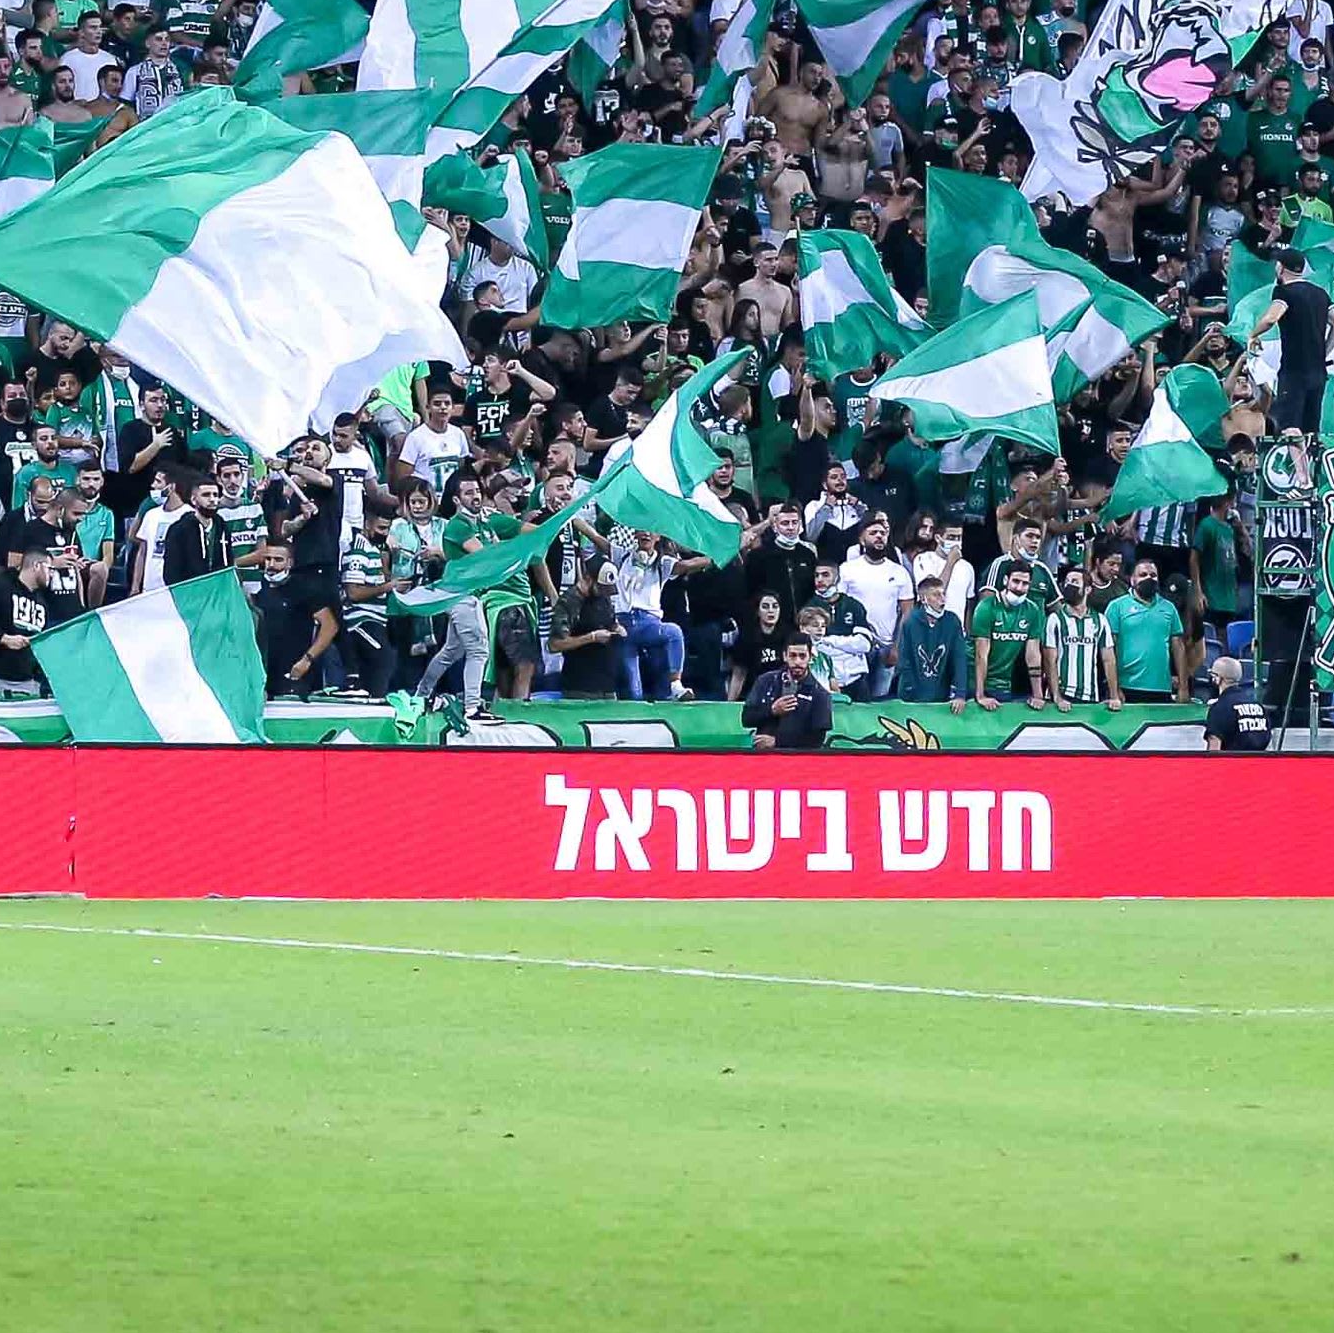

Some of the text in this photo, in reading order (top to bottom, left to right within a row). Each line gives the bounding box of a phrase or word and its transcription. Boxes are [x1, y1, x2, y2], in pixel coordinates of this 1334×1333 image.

[1259, 133, 1294, 143] HONDA
[477, 404, 512, 423] FCK
[229, 533, 259, 545] ONDA
[10, 594, 47, 630] 1913
[991, 630, 1028, 641] VOLVO
[1063, 635, 1096, 646] HONDA
[544, 773, 1054, 874] חדש בישראל
